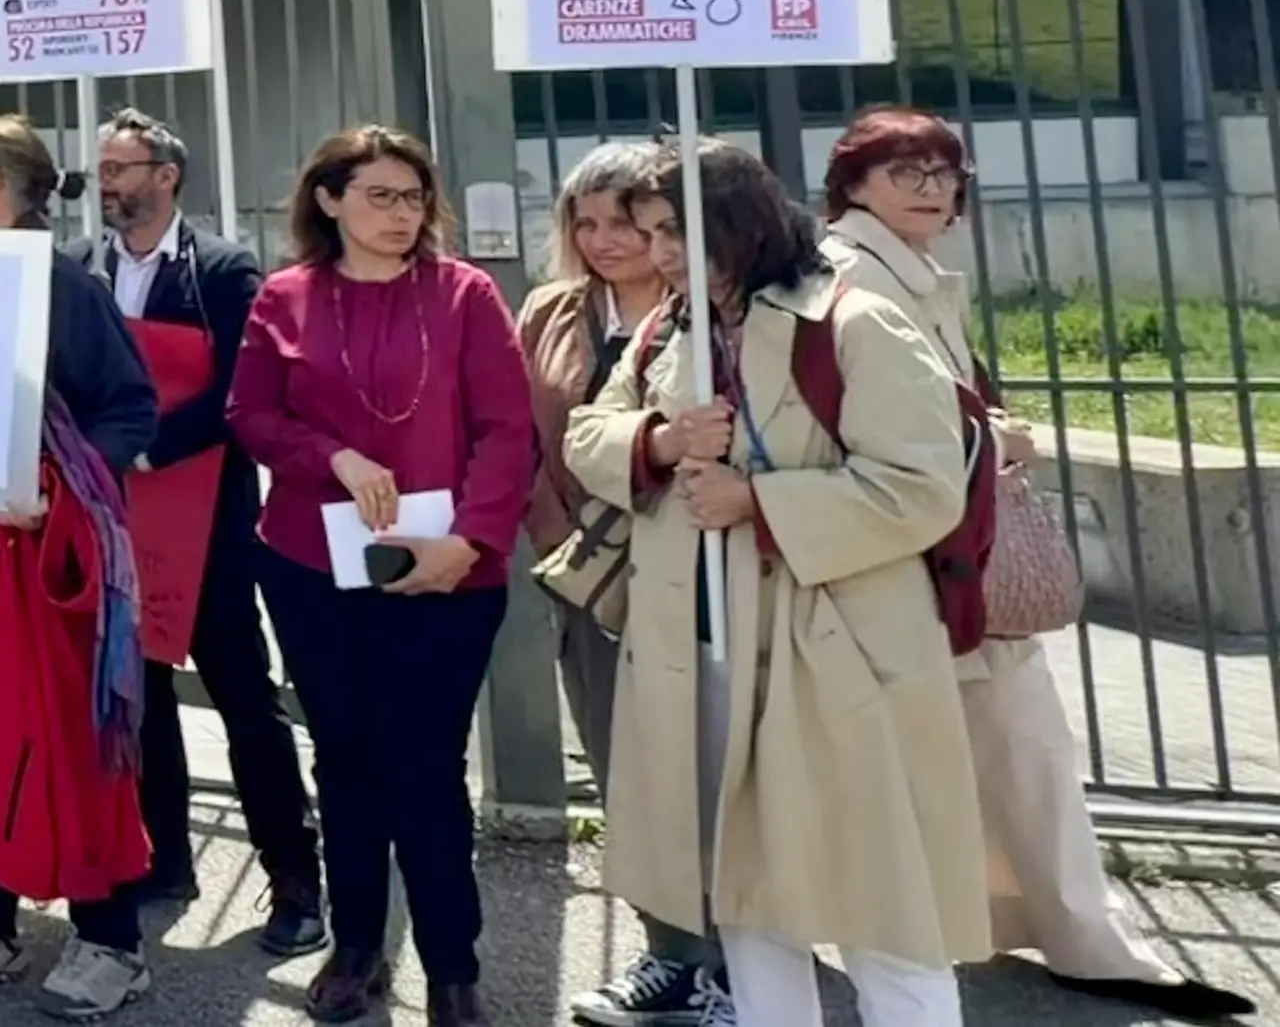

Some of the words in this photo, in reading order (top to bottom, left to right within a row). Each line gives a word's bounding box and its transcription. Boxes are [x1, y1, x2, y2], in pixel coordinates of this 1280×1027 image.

[102, 29, 146, 55] 157
[562, 20, 691, 42] DRAMMATICHE
[9, 36, 35, 62] 52
